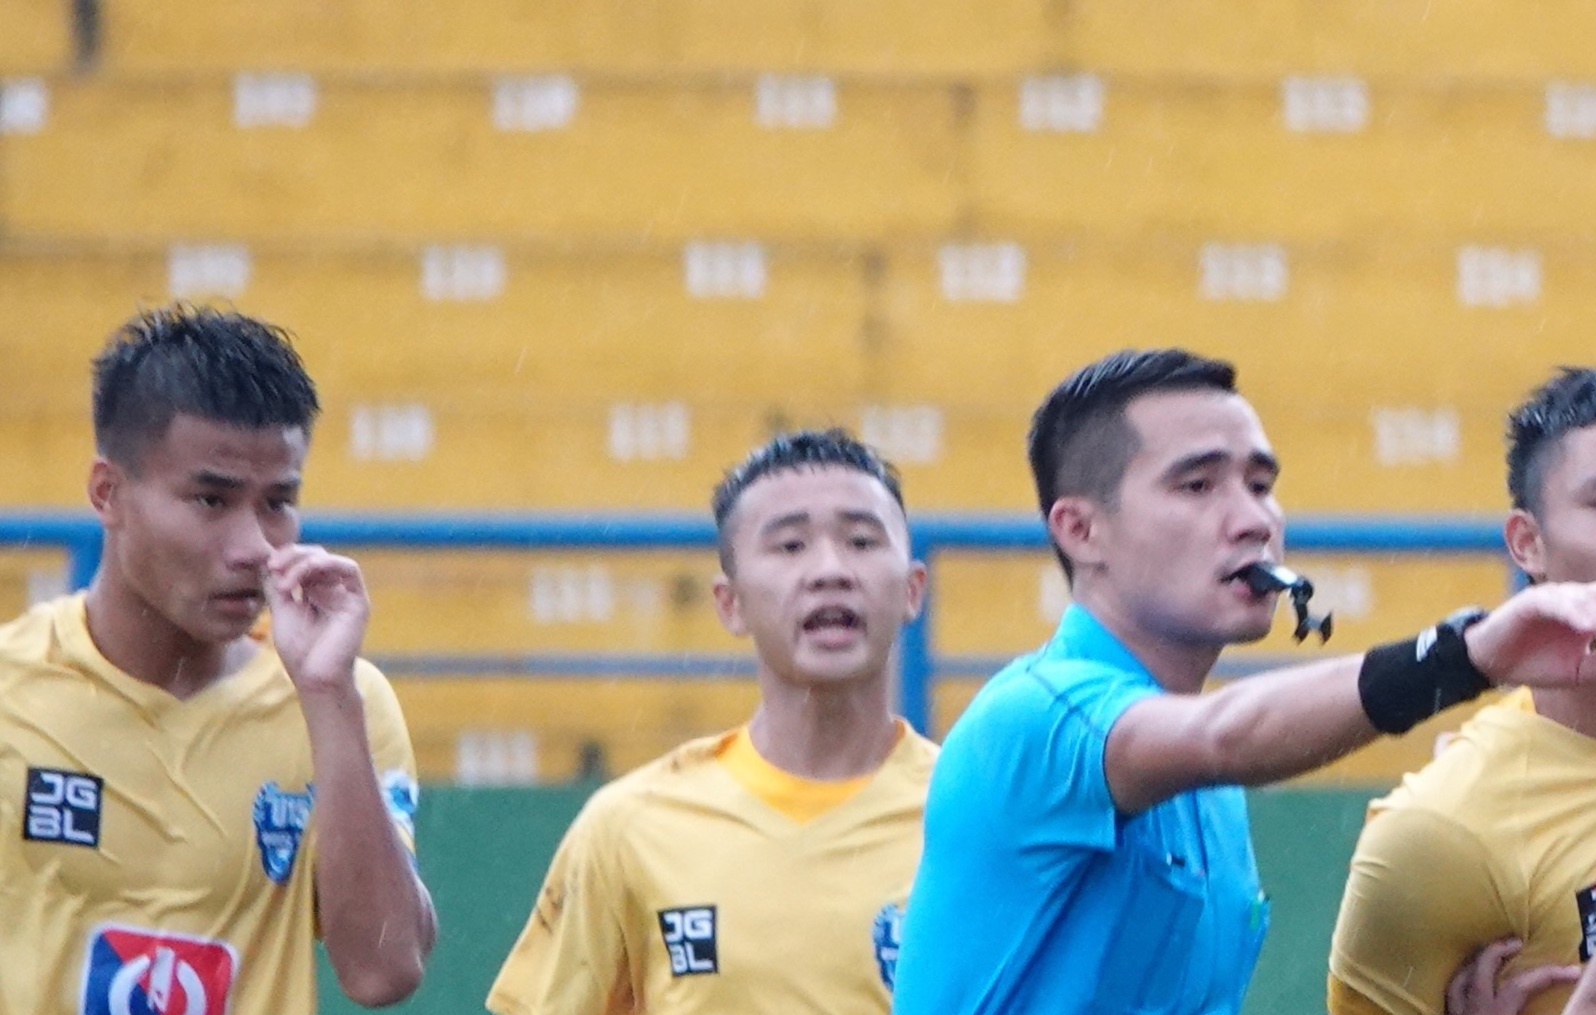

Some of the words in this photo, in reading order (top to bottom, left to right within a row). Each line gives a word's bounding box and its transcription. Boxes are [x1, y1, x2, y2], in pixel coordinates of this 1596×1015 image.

[31, 772, 97, 810] JG
[29, 805, 95, 844] BL
[664, 908, 713, 942] JG
[669, 943, 713, 973] BL
